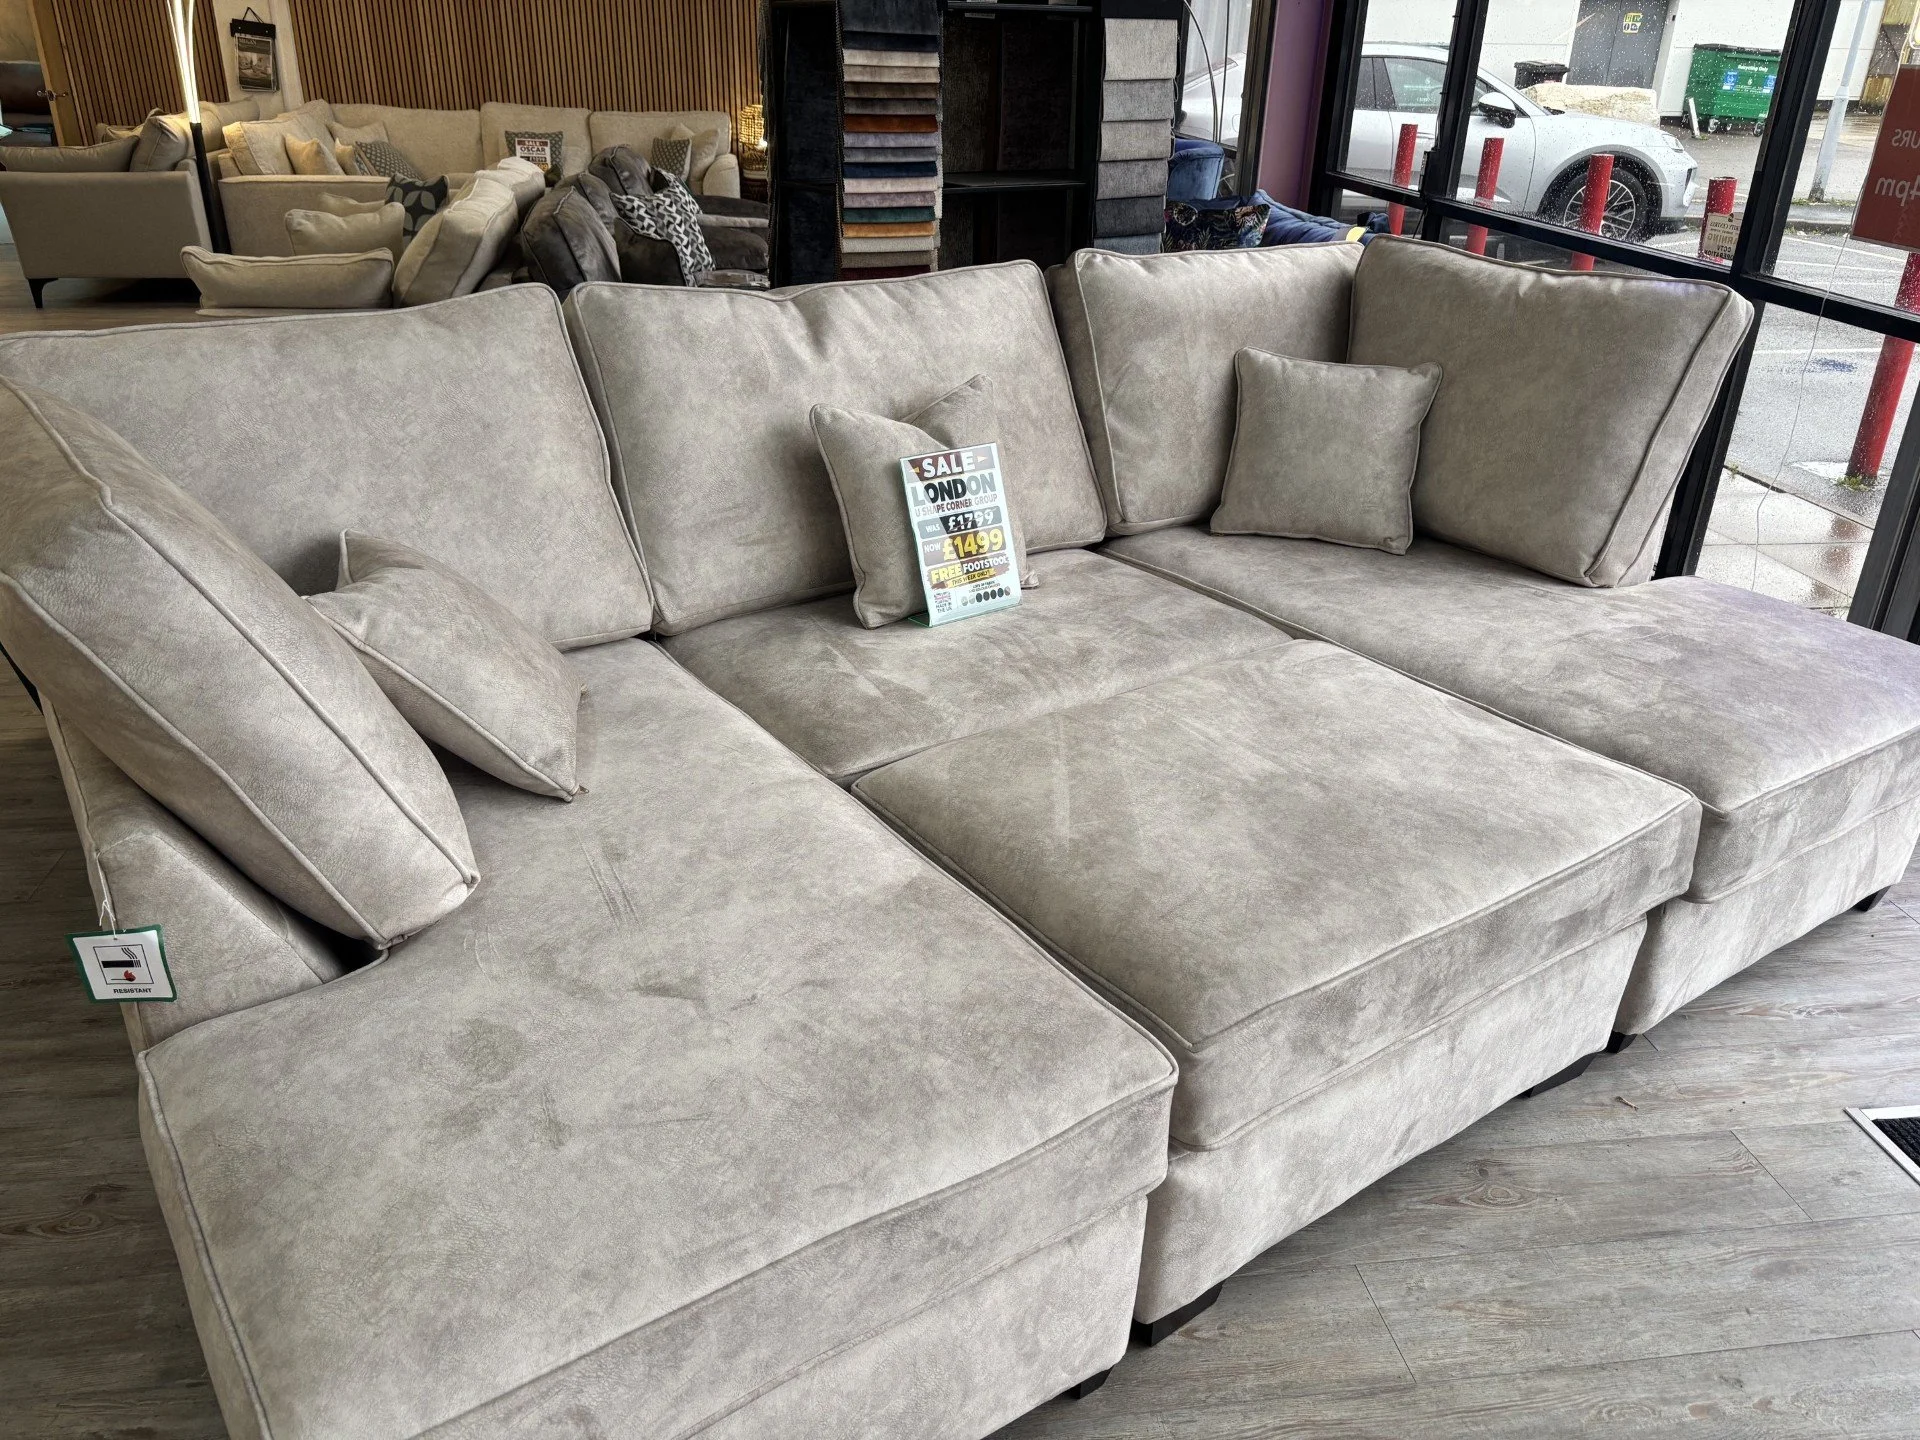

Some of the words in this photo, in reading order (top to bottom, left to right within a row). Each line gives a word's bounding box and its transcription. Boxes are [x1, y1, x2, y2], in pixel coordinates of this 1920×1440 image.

[922, 451, 976, 478] SALE
[910, 471, 997, 507] LONDON
[922, 504, 946, 516] SHAPE
[946, 499, 973, 512] CORNER
[974, 493, 998, 506] GROUP
[925, 523, 941, 533] WAS
[948, 508, 994, 532] £1799
[924, 542, 941, 553] NOW
[942, 528, 1004, 561] £1499
[931, 563, 962, 585] FREE
[962, 555, 1009, 574] FOOTSTOOL
[952, 577, 963, 586] THIS
[963, 573, 976, 583] WEEK
